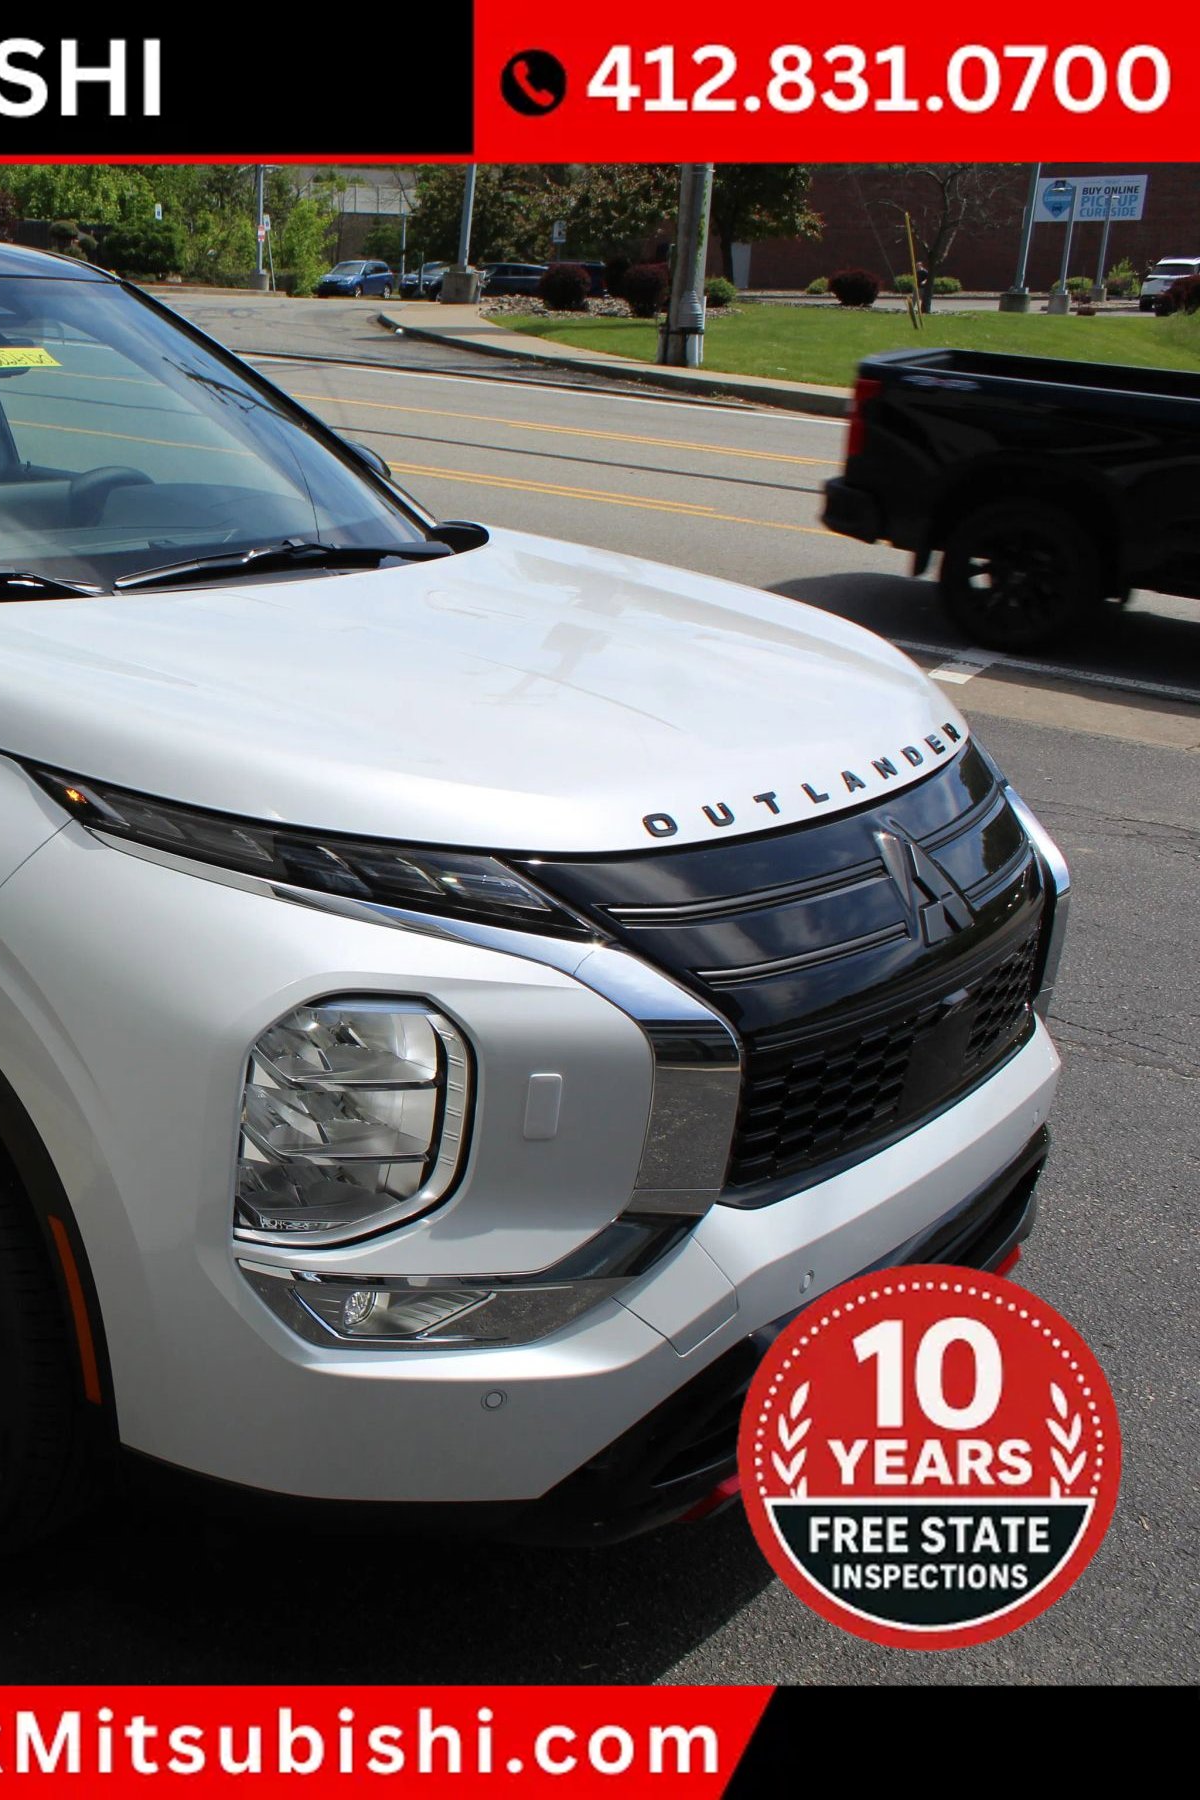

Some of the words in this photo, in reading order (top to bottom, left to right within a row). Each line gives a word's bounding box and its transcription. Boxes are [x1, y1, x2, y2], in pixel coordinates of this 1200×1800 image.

[1082, 187, 1102, 195] BUY
[1104, 186, 1140, 194] ONLINE
[1081, 195, 1111, 207] PIC
[1118, 195, 1138, 207] UP
[642, 722, 962, 838] OUTLANDER
